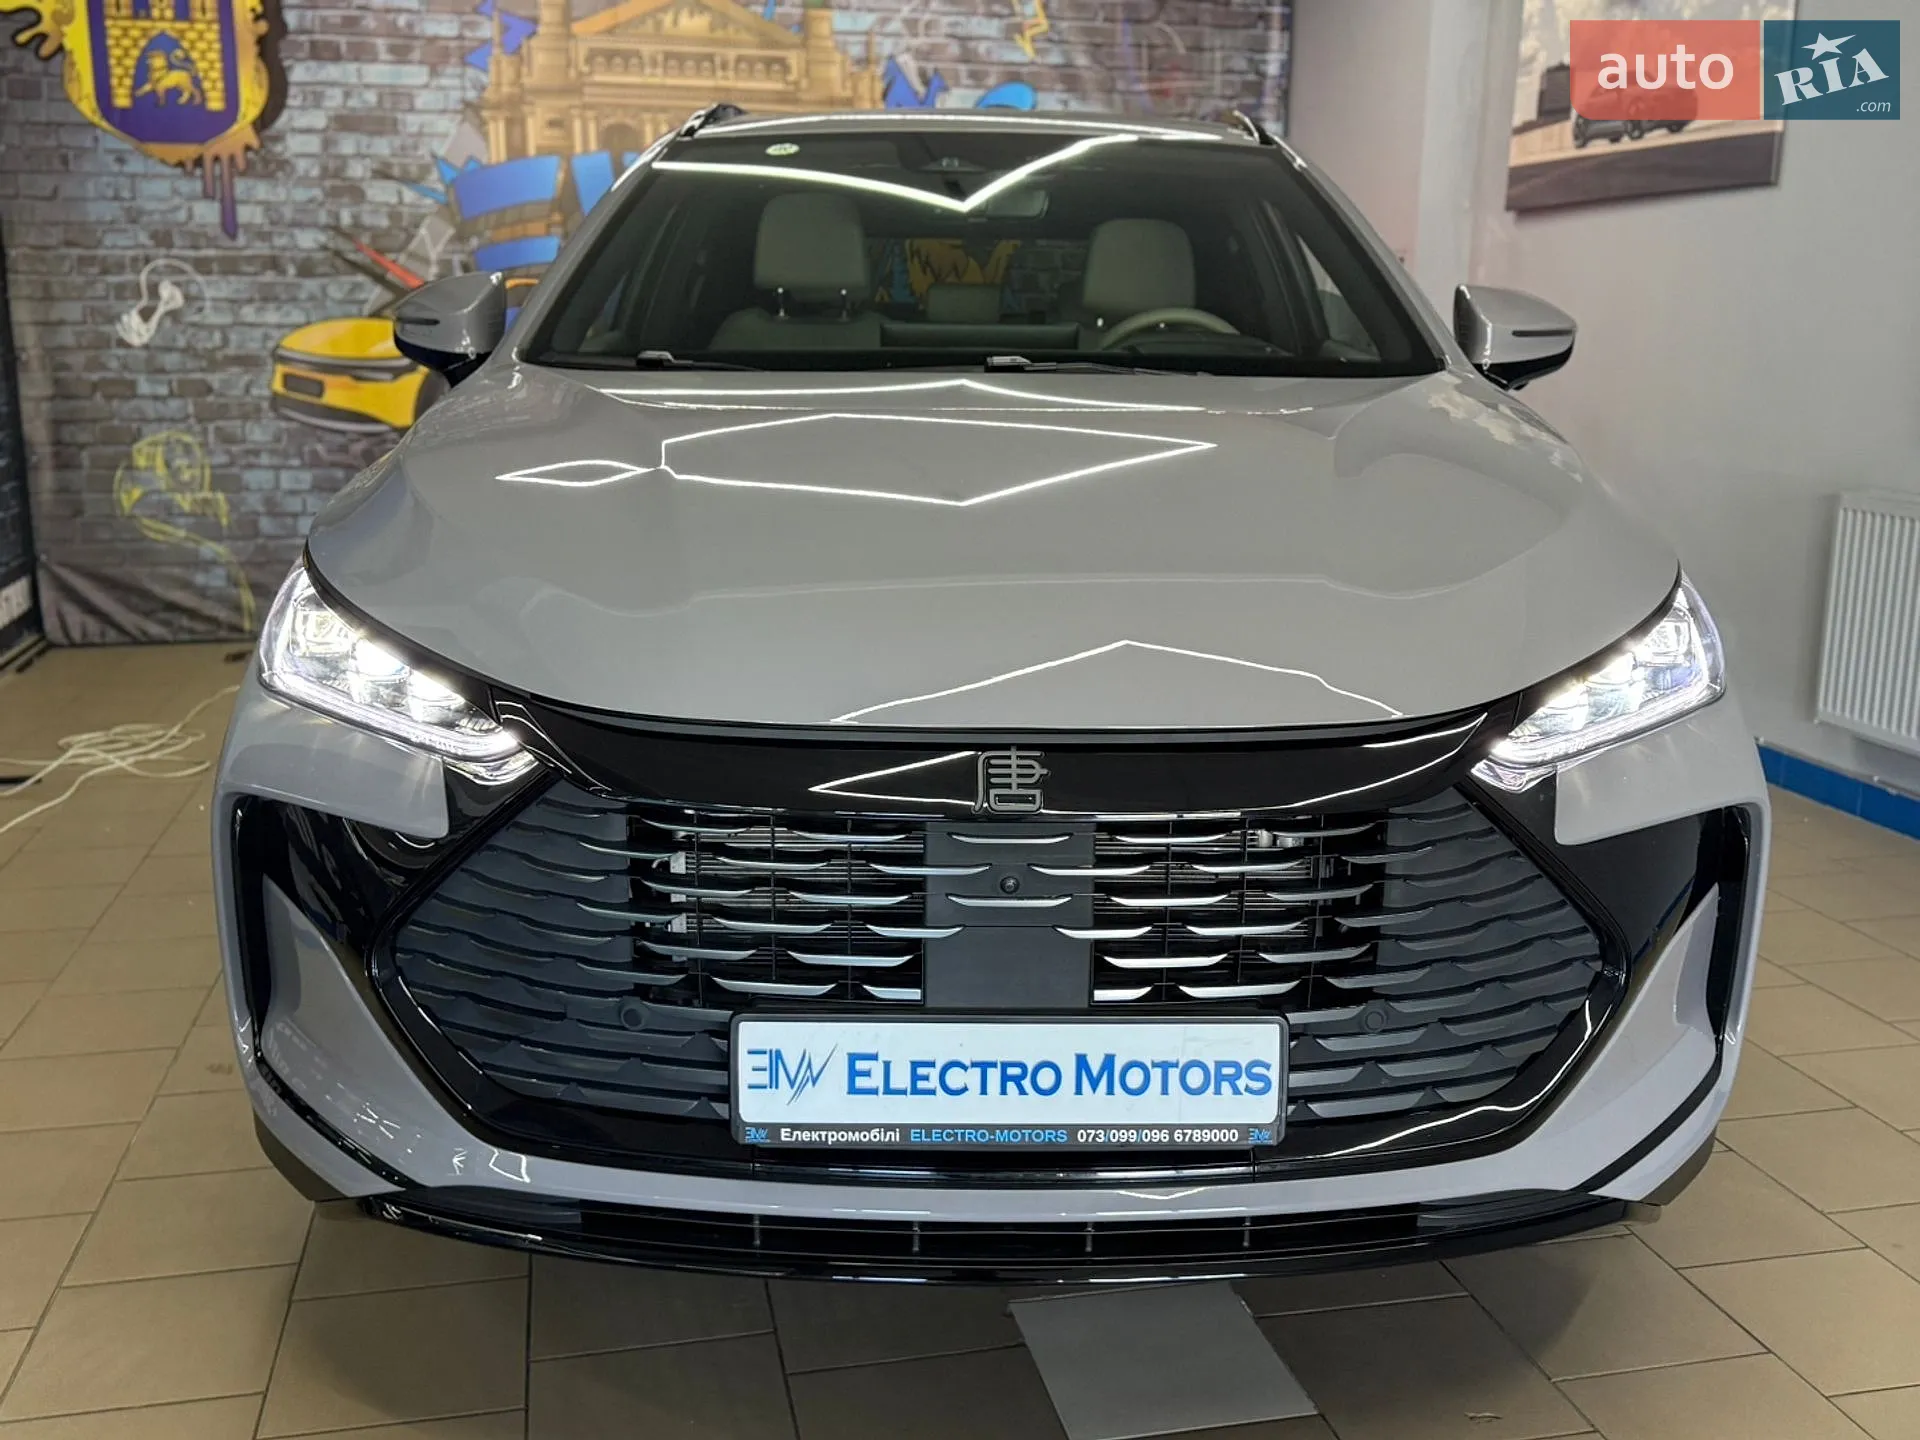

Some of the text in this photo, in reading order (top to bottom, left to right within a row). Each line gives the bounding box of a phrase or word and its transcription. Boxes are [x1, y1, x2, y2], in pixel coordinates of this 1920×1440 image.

[971, 746, 1048, 814] 唐
[846, 1051, 1273, 1098] ELECTRO MOTORS
[780, 1127, 1239, 1145] Електромобілі ELECTRO-MOTORS 073/099/096 6789000
